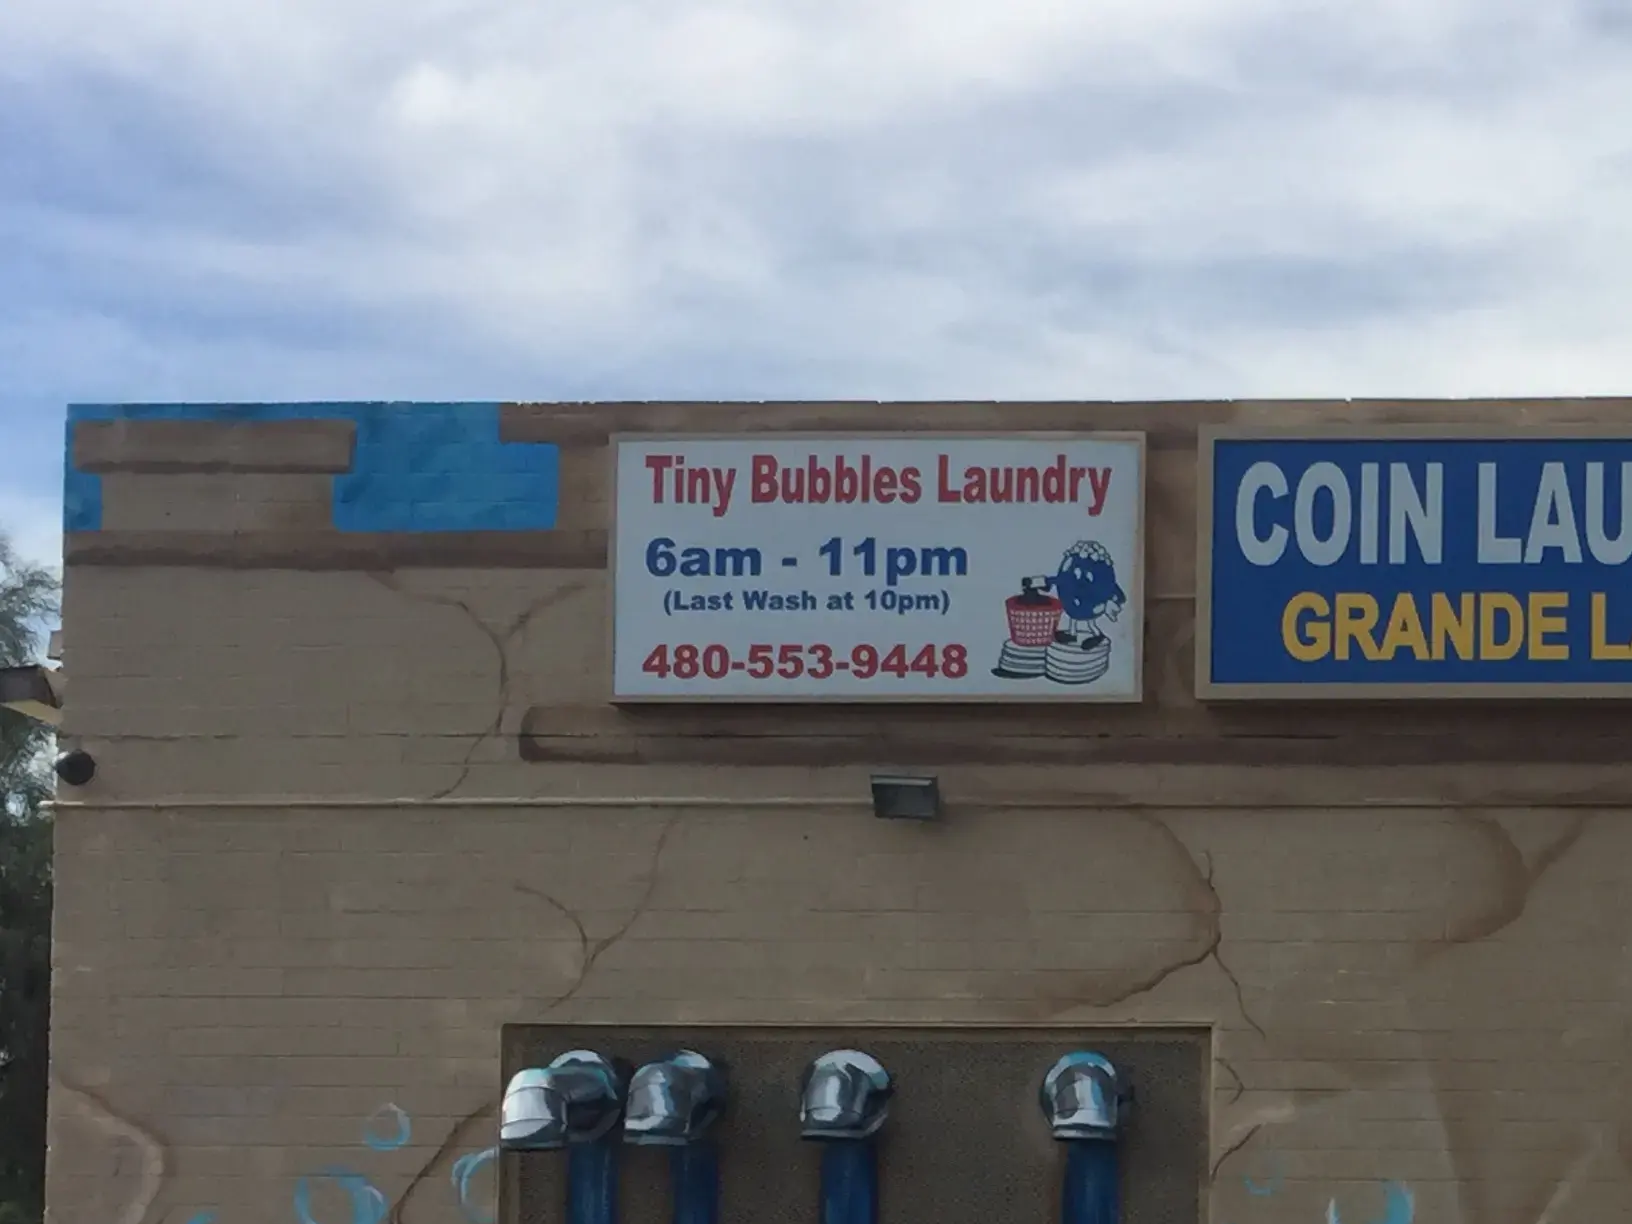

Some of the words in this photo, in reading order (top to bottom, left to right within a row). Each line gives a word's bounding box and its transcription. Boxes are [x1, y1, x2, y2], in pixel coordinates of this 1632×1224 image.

[645, 455, 735, 517] Tiny
[750, 454, 921, 504] Bubbles
[937, 454, 1112, 516] Laundry
[1235, 460, 1444, 566] COIN
[644, 536, 762, 577] 6am
[780, 555, 798, 569] -
[818, 535, 968, 585] 11pm
[662, 589, 735, 616] (Last
[742, 589, 818, 612] Wash
[825, 591, 855, 612] at
[862, 588, 952, 616] 10pm)
[1281, 591, 1570, 661] GRANDE
[642, 643, 969, 680] 480-553-9448
